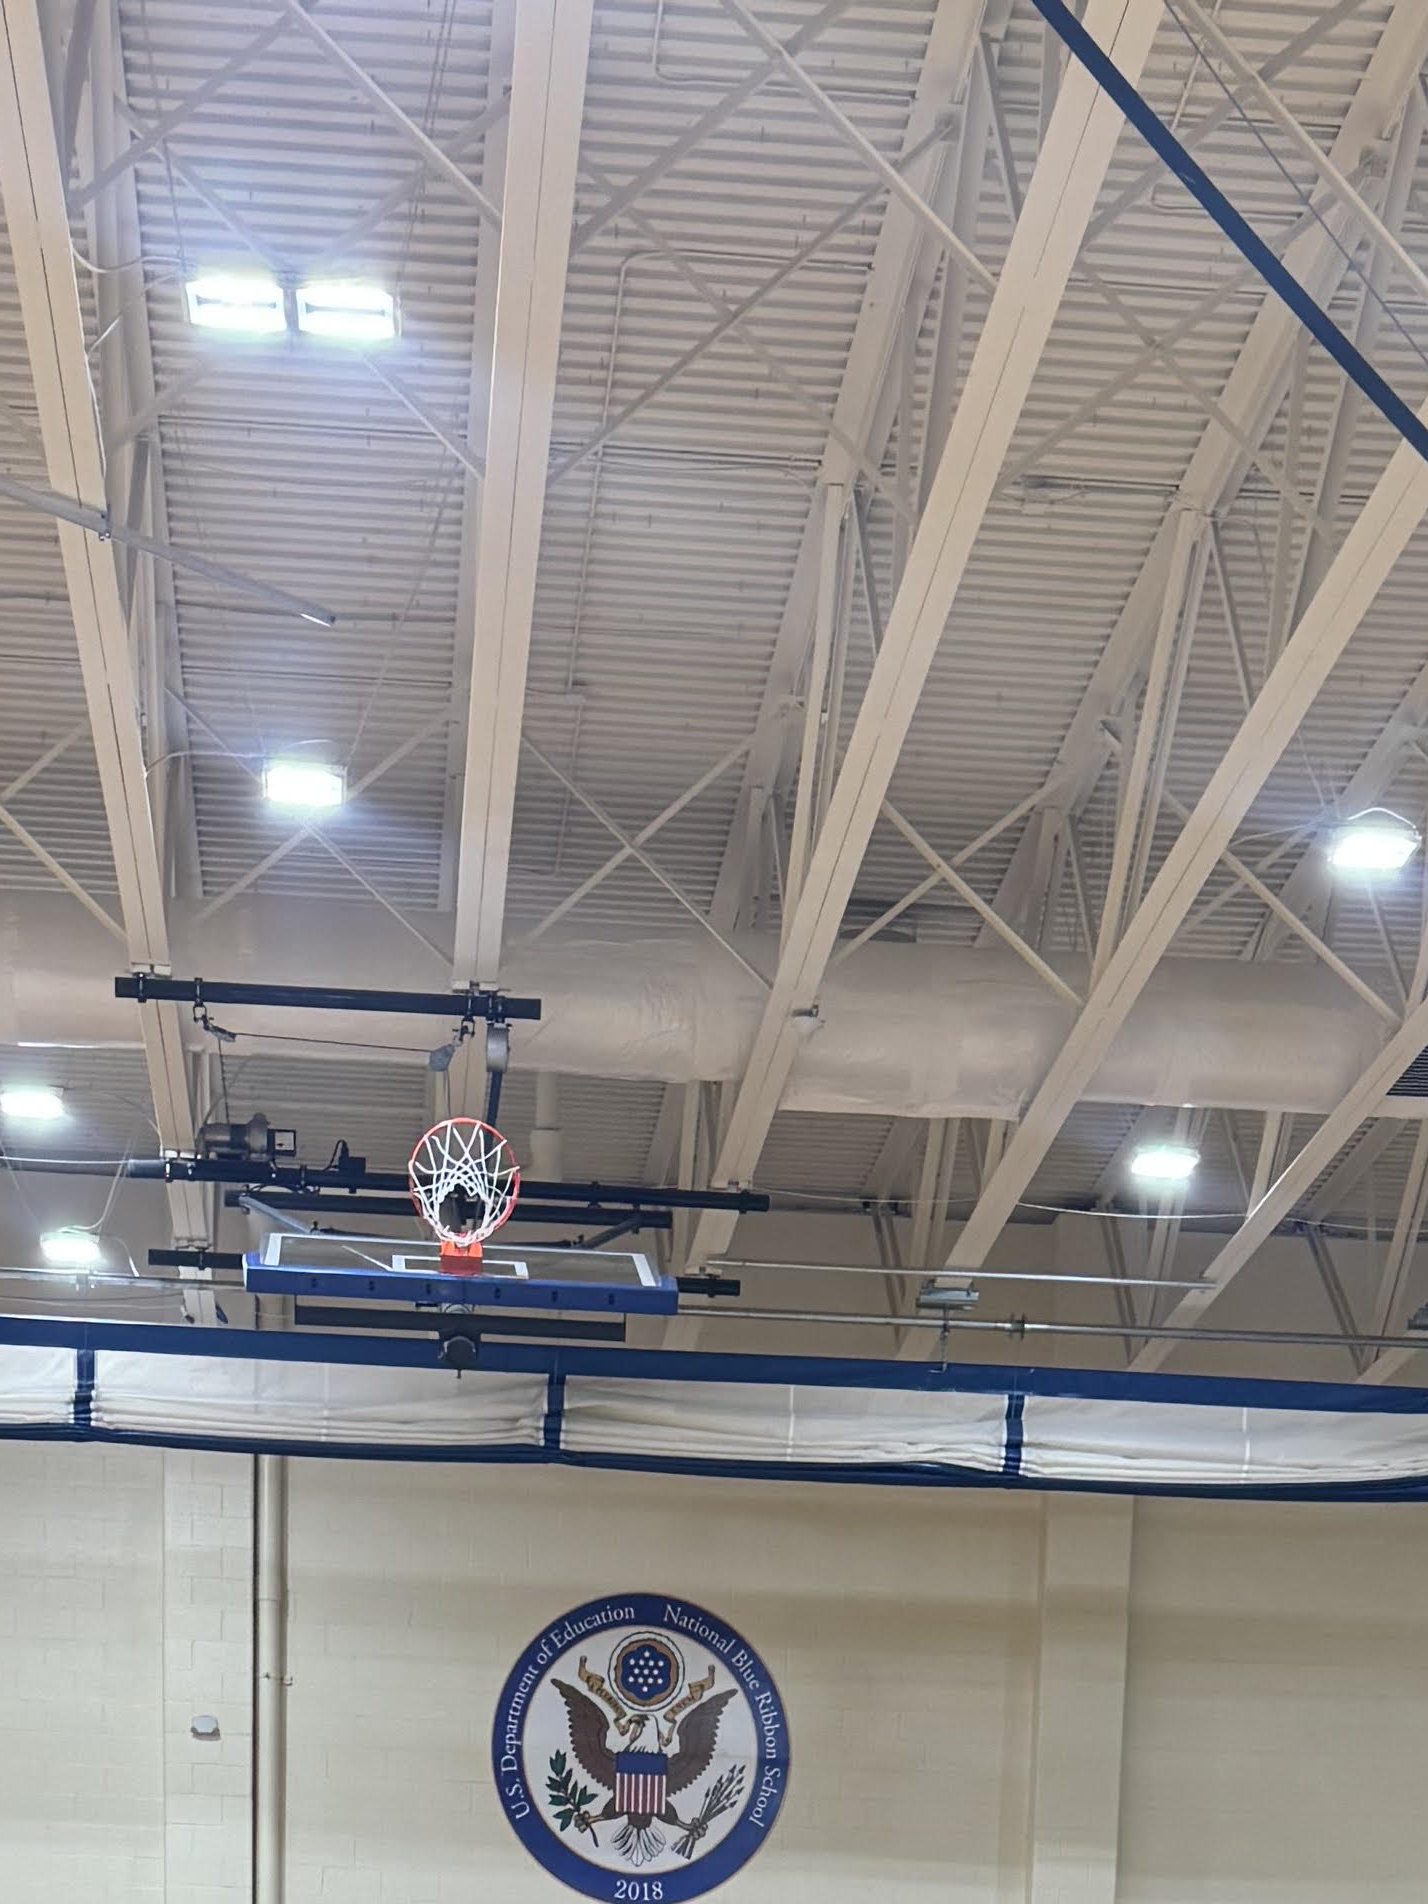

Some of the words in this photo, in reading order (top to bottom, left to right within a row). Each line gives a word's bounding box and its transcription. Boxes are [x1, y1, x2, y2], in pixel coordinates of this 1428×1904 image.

[551, 1604, 635, 1649] Education
[664, 1604, 733, 1653] National
[536, 1645, 555, 1664] of
[731, 1653, 760, 1691] Blue
[501, 1665, 539, 1771] Department
[755, 1691, 780, 1760] Ribbon
[749, 1766, 781, 1828] School
[614, 1880, 664, 1901] 2018
